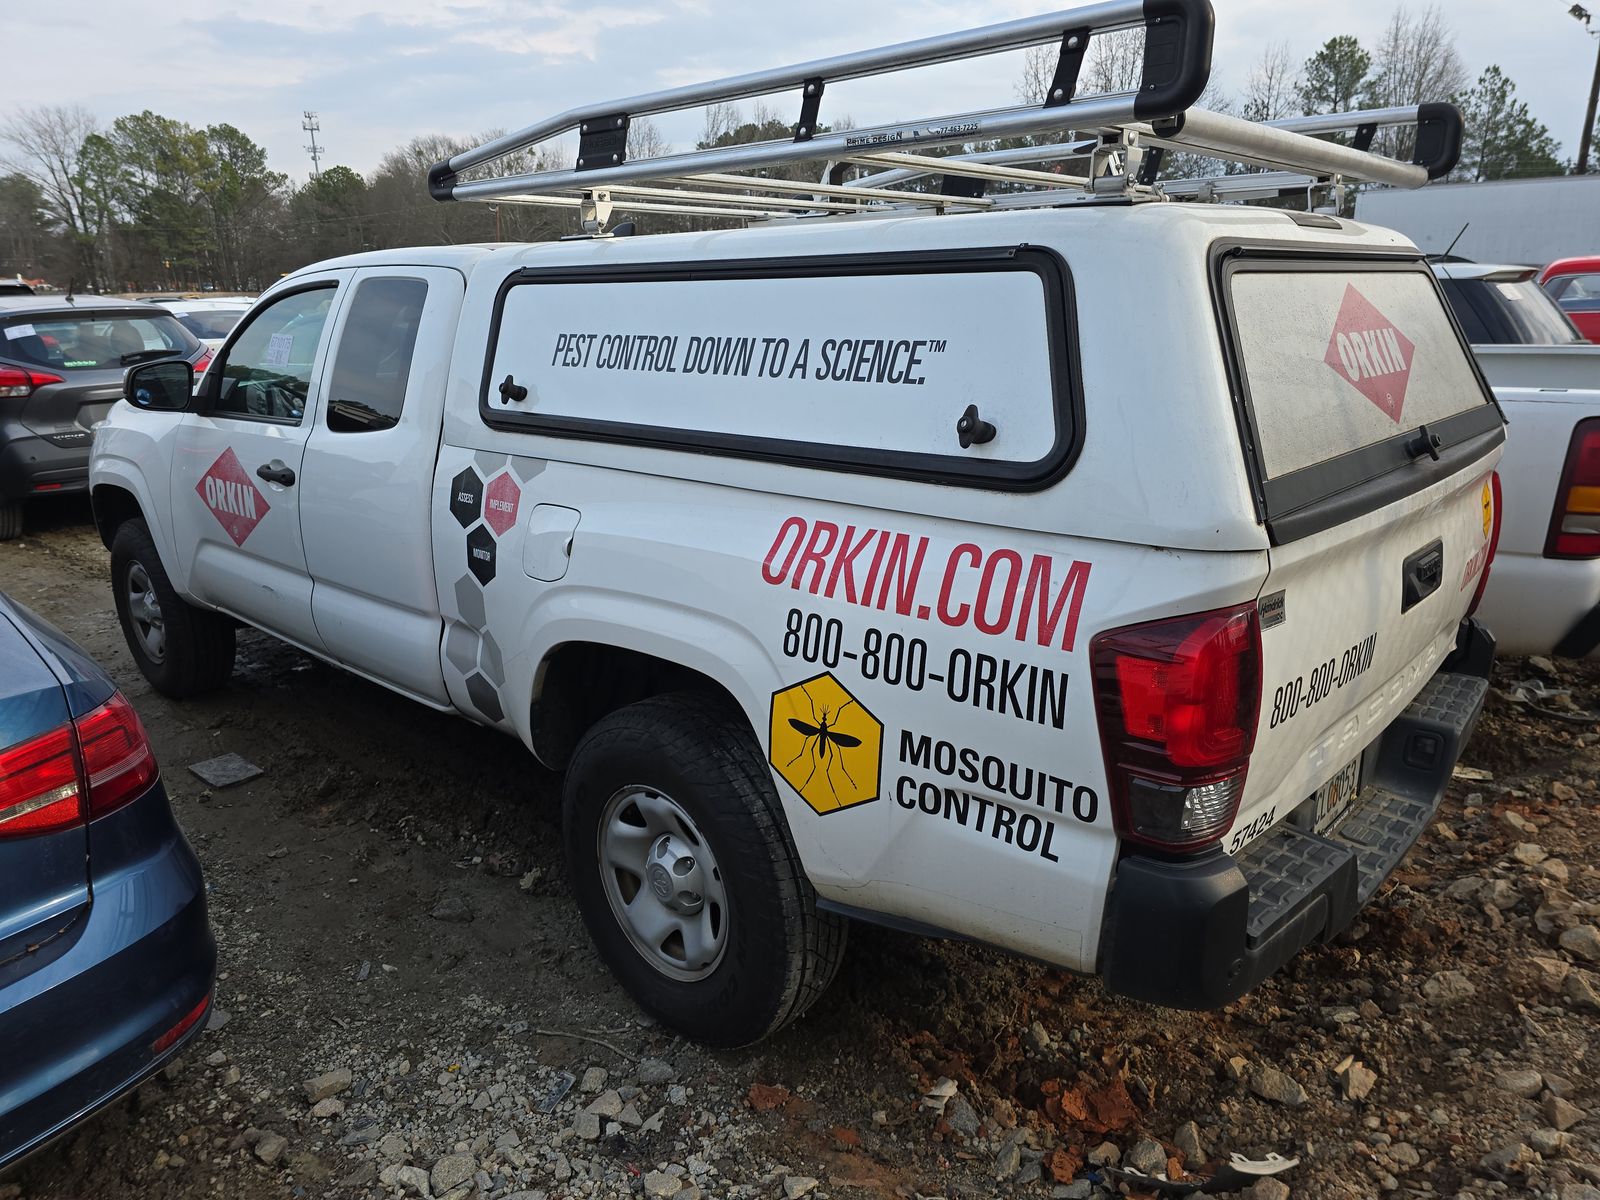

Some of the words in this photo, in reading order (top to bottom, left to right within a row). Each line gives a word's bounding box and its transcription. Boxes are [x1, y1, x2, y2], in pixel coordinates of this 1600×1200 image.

[846, 137, 871, 147] PRIME
[873, 131, 903, 144] DESIGN
[552, 333, 597, 368] PEST
[596, 334, 678, 373] CONTROL
[682, 336, 756, 378] DOWN
[758, 337, 790, 379] TO
[788, 338, 810, 380] A
[1336, 328, 1407, 382] ORKIN
[205, 475, 257, 520] ORKIN
[457, 491, 474, 505] ASSESS
[489, 498, 514, 514] IMPLEMENT
[472, 547, 491, 562] MONITOR
[761, 516, 1093, 653] ORKIN.COM
[783, 608, 1069, 730] 800-800-ORKIN
[1270, 632, 1378, 730] 800-800-ORKIN
[899, 729, 1099, 823] MOSQUITO
[896, 775, 1060, 863] CONTROL
[1229, 805, 1277, 855] 57424
